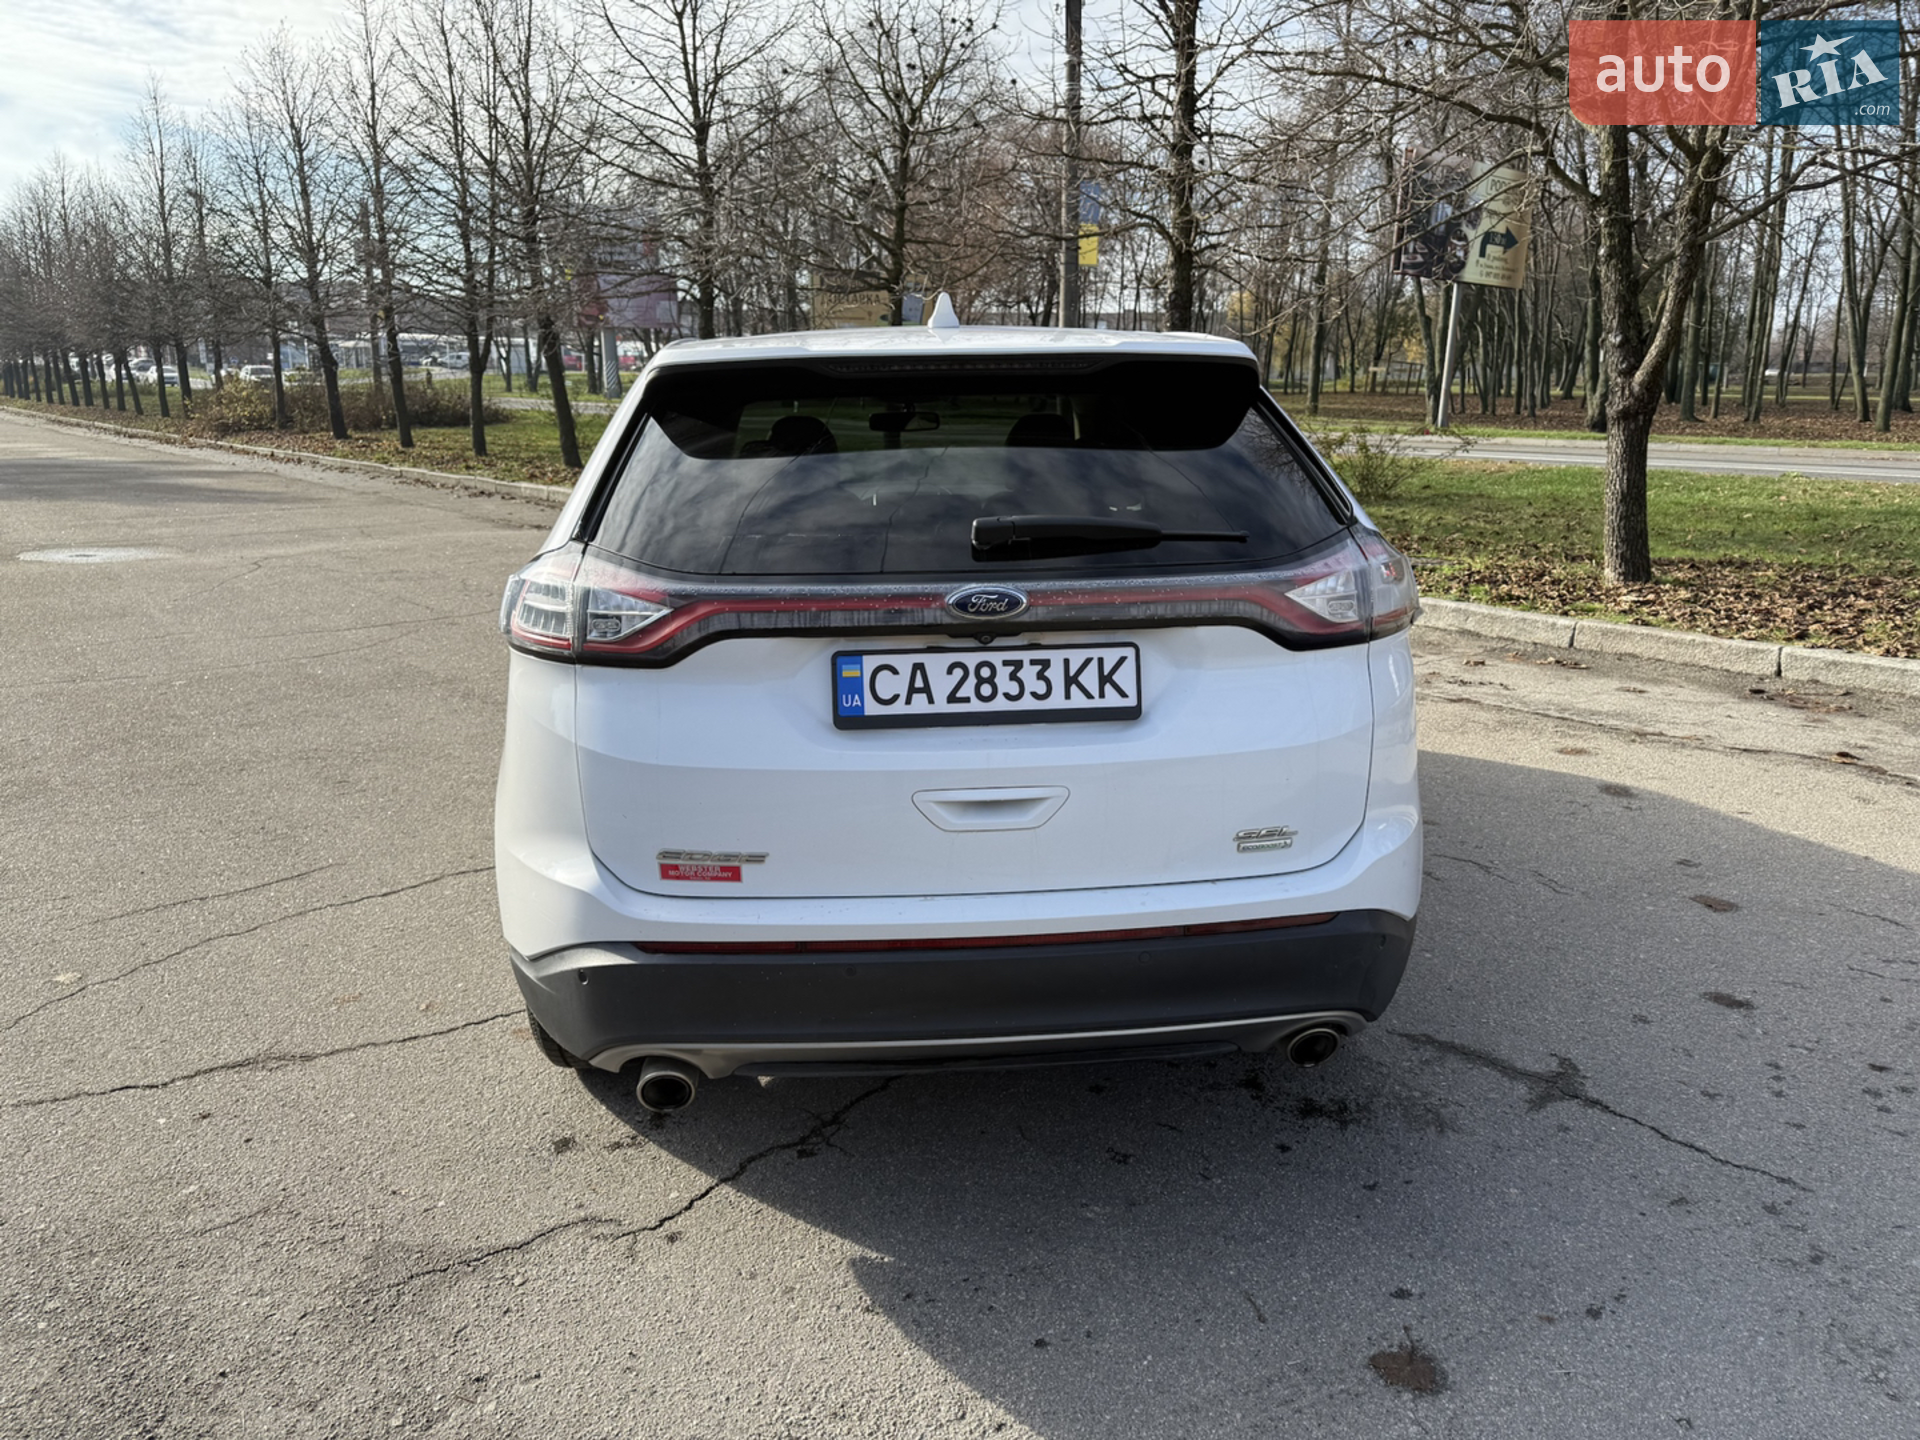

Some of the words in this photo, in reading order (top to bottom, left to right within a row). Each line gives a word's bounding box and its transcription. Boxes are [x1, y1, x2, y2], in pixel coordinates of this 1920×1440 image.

[967, 593, 1008, 613] Ford
[868, 662, 935, 706] CA
[946, 658, 1053, 704] 2833
[1063, 655, 1130, 701] KK
[842, 694, 862, 708] UA
[1233, 825, 1298, 842] SEL
[656, 848, 769, 863] EDGE
[668, 869, 696, 877] MOTOR
[678, 864, 721, 872] WEBSTER
